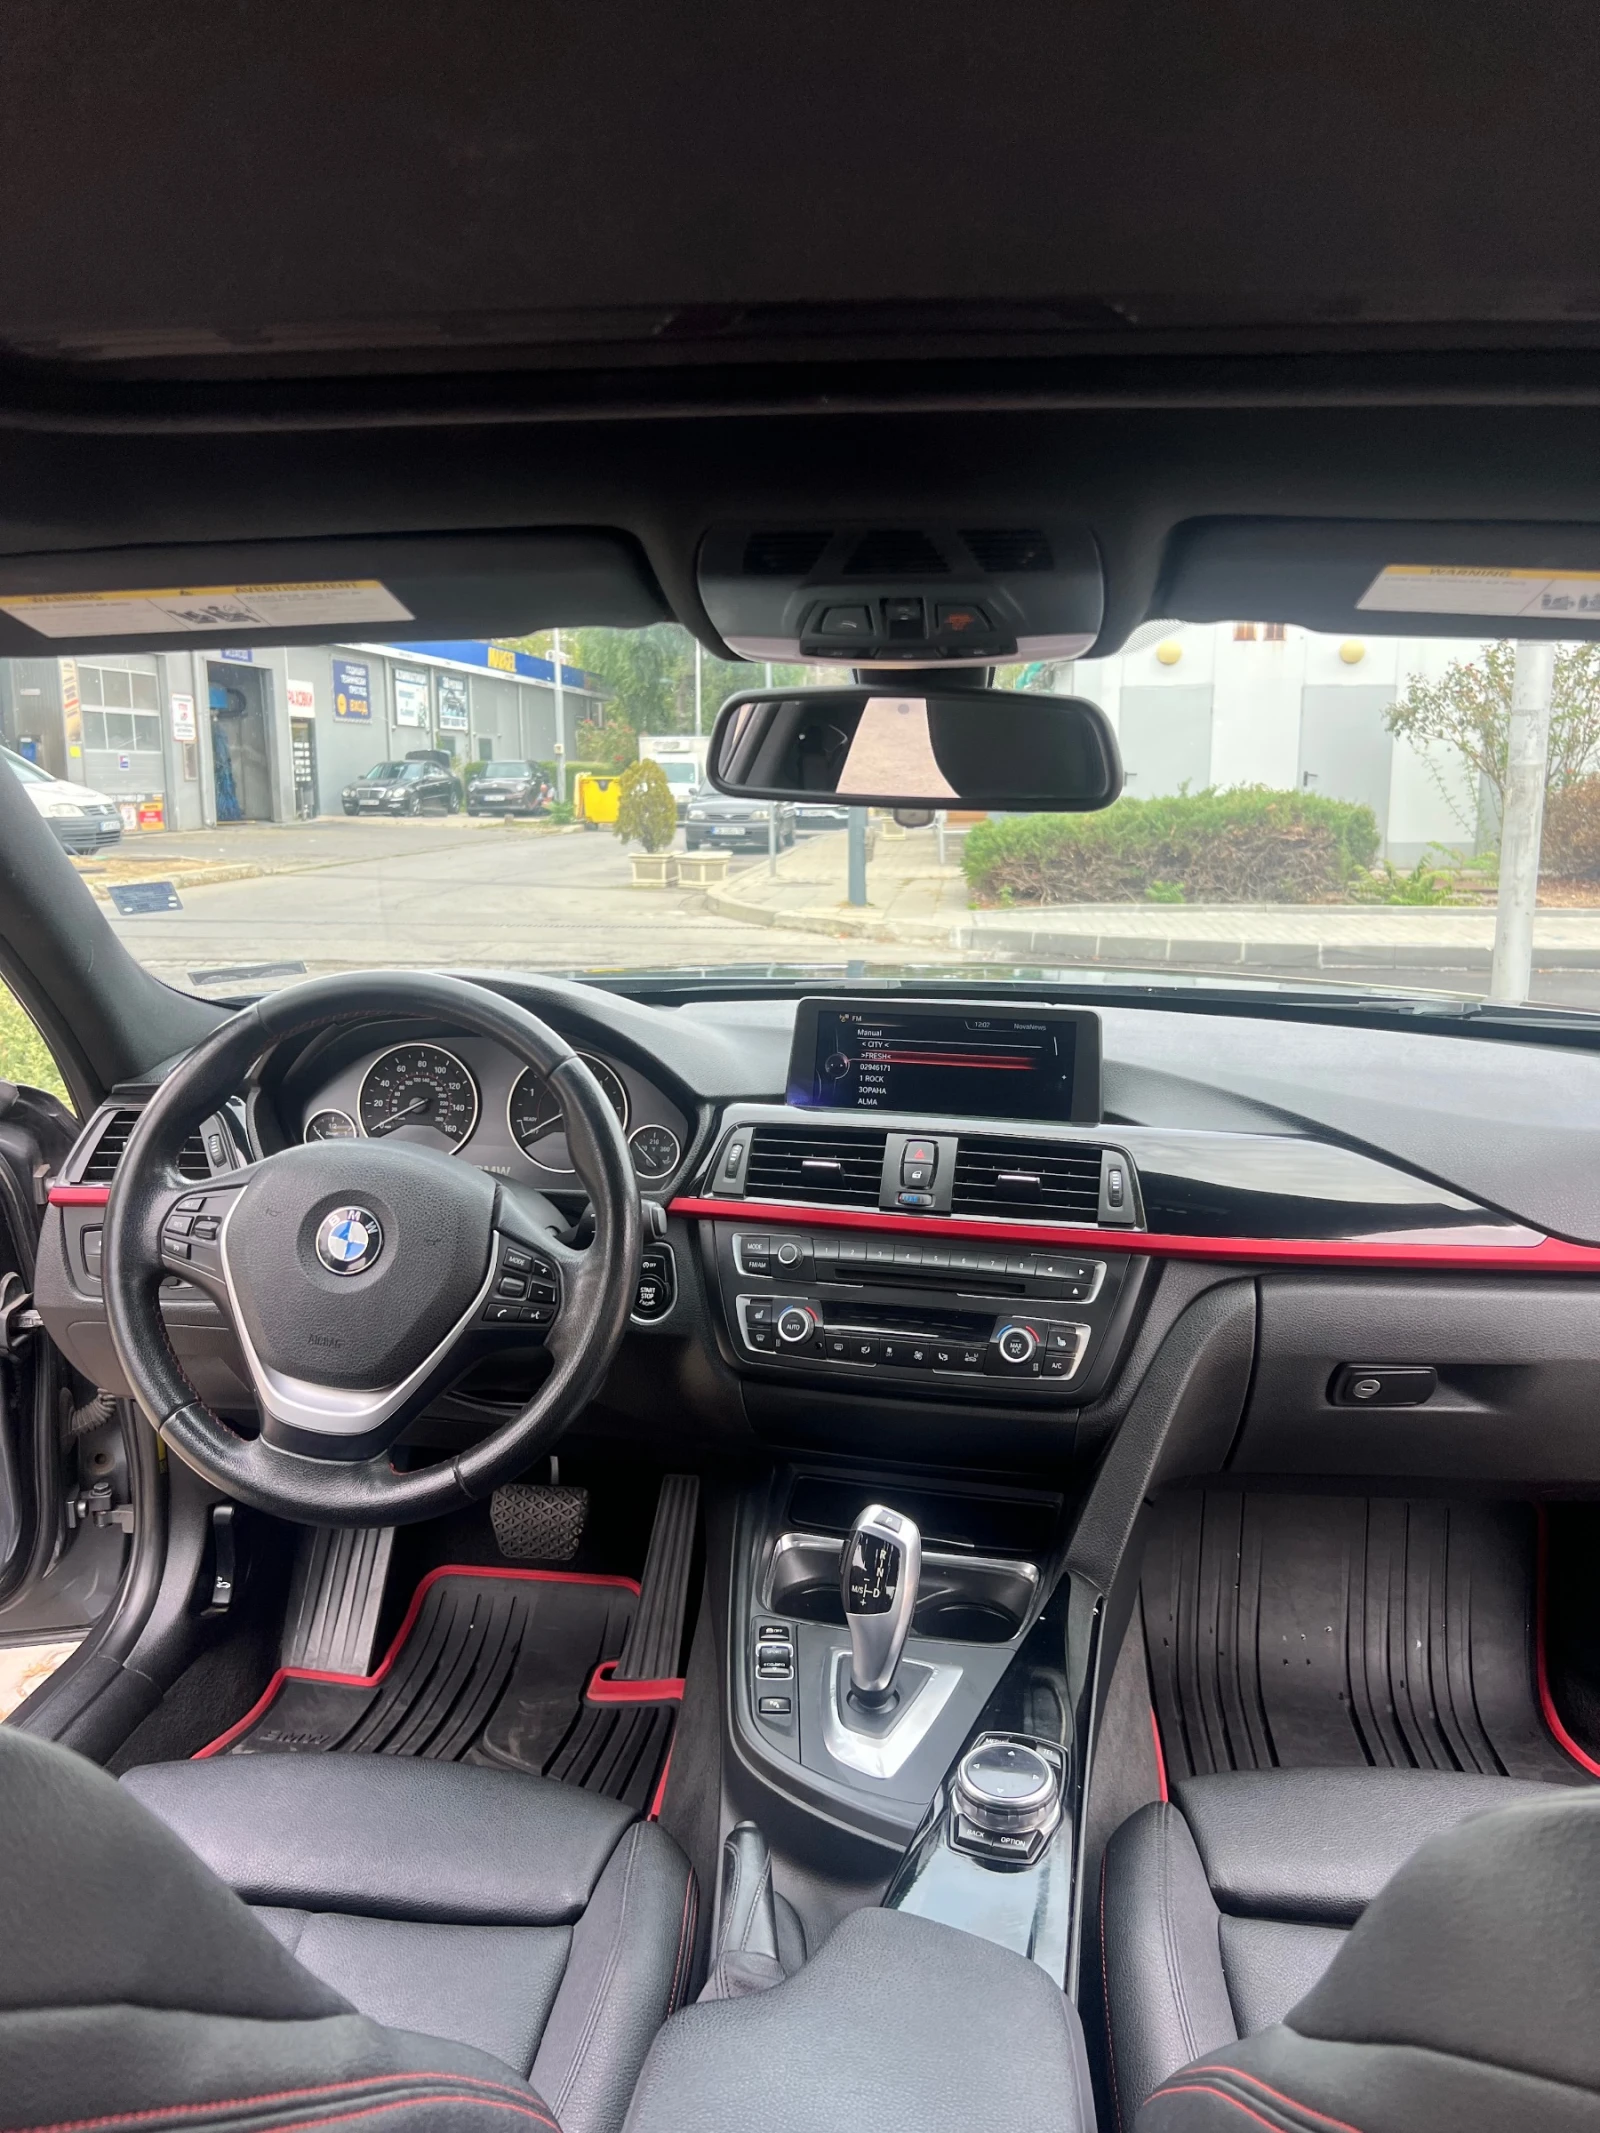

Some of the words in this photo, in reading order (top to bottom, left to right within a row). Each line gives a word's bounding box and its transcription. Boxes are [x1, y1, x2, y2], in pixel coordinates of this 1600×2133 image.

[1429, 568, 1513, 578] WARNING
[235, 583, 358, 593] AVERTISSEMENT
[1013, 1023, 1047, 1031] NovaNews
[417, 1060, 427, 1068] 80
[396, 1065, 406, 1073] 60
[434, 1066, 447, 1074] 100
[380, 1079, 390, 1087] 40
[865, 1075, 884, 1083] ROCK
[448, 1082, 461, 1090] 120
[373, 1099, 384, 1107] 20
[452, 1103, 465, 1112] 140
[444, 1124, 457, 1133] 160
[328, 1210, 378, 1234] BMW
[508, 1256, 525, 1266] MODE
[880, 1549, 887, 1560] R
[876, 1568, 884, 1578] N
[851, 1585, 863, 1594] M/S
[873, 1588, 880, 1598] D
[966, 1828, 985, 1838] BACK
[1000, 1836, 1026, 1847] OPTION
